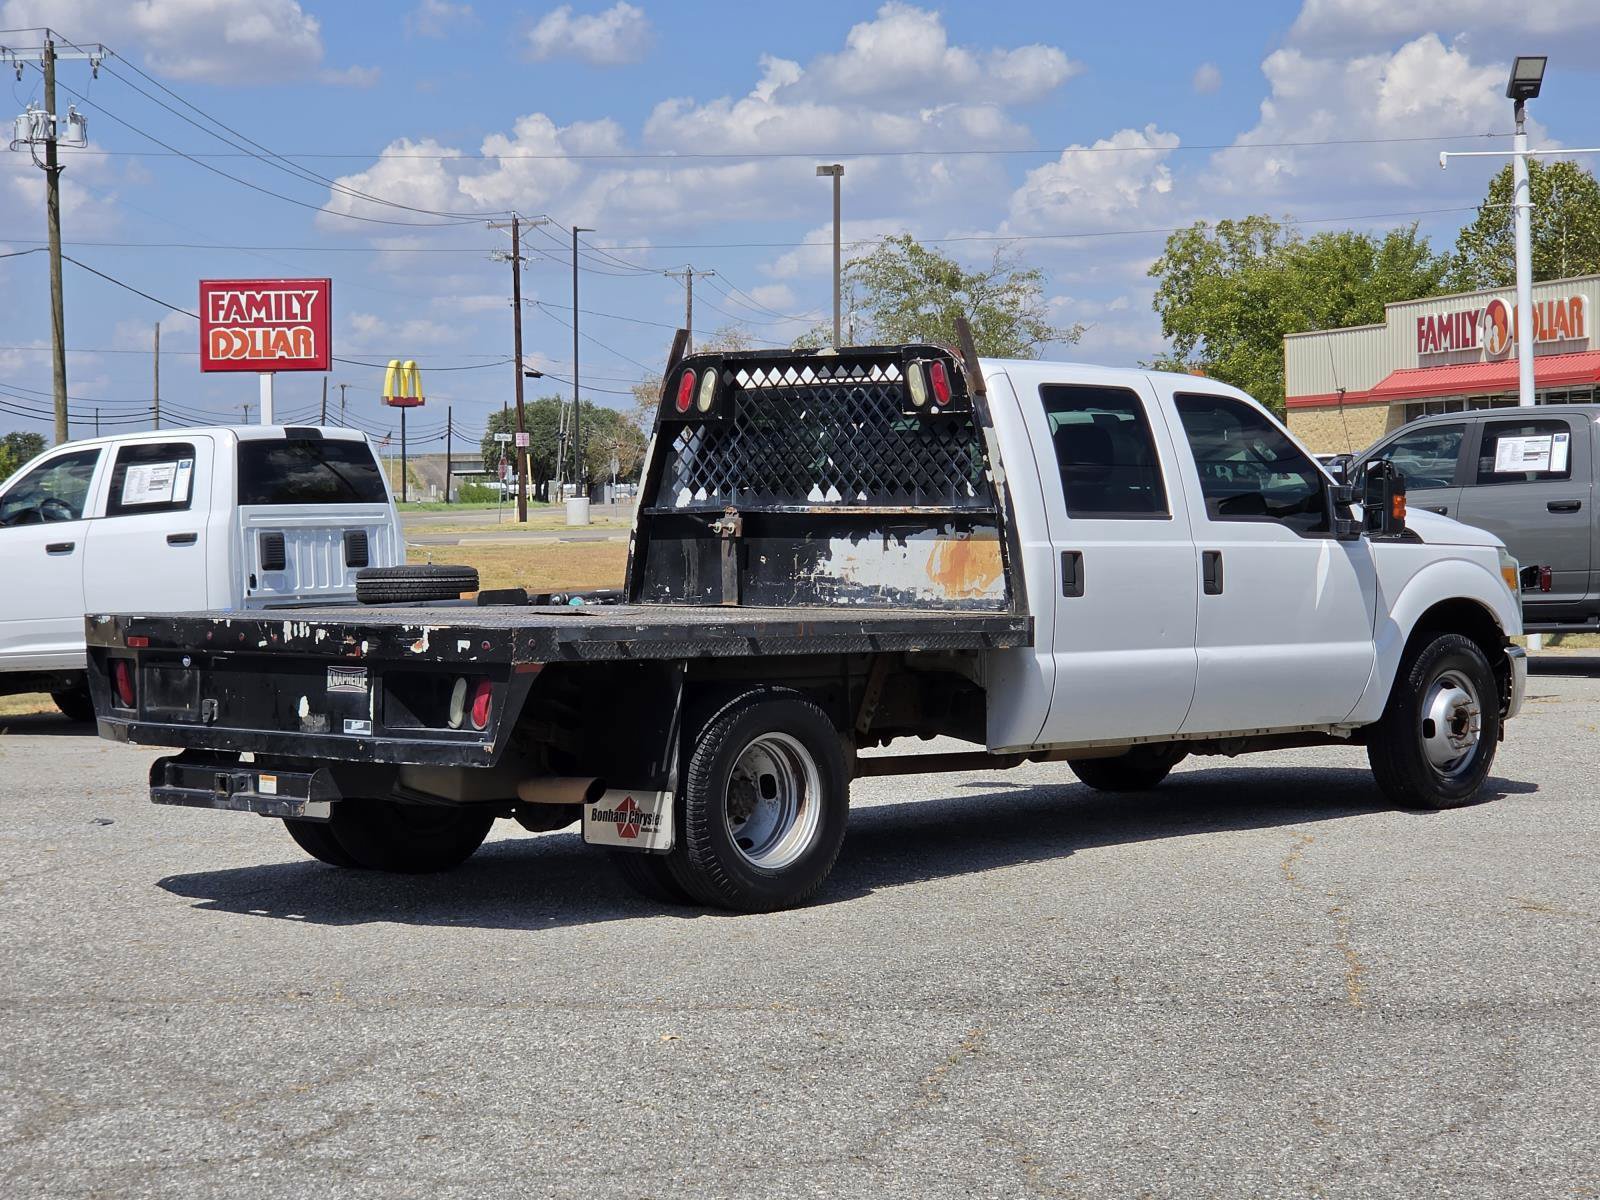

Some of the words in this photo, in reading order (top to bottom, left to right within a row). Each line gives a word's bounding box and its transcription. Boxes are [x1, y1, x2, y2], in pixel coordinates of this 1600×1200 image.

[208, 290, 318, 323] FAMILY
[209, 326, 315, 360] DOLLAR
[1417, 309, 1482, 354] FAMILY
[327, 669, 367, 690] KNAPHEIDE
[591, 808, 627, 823] Bonham
